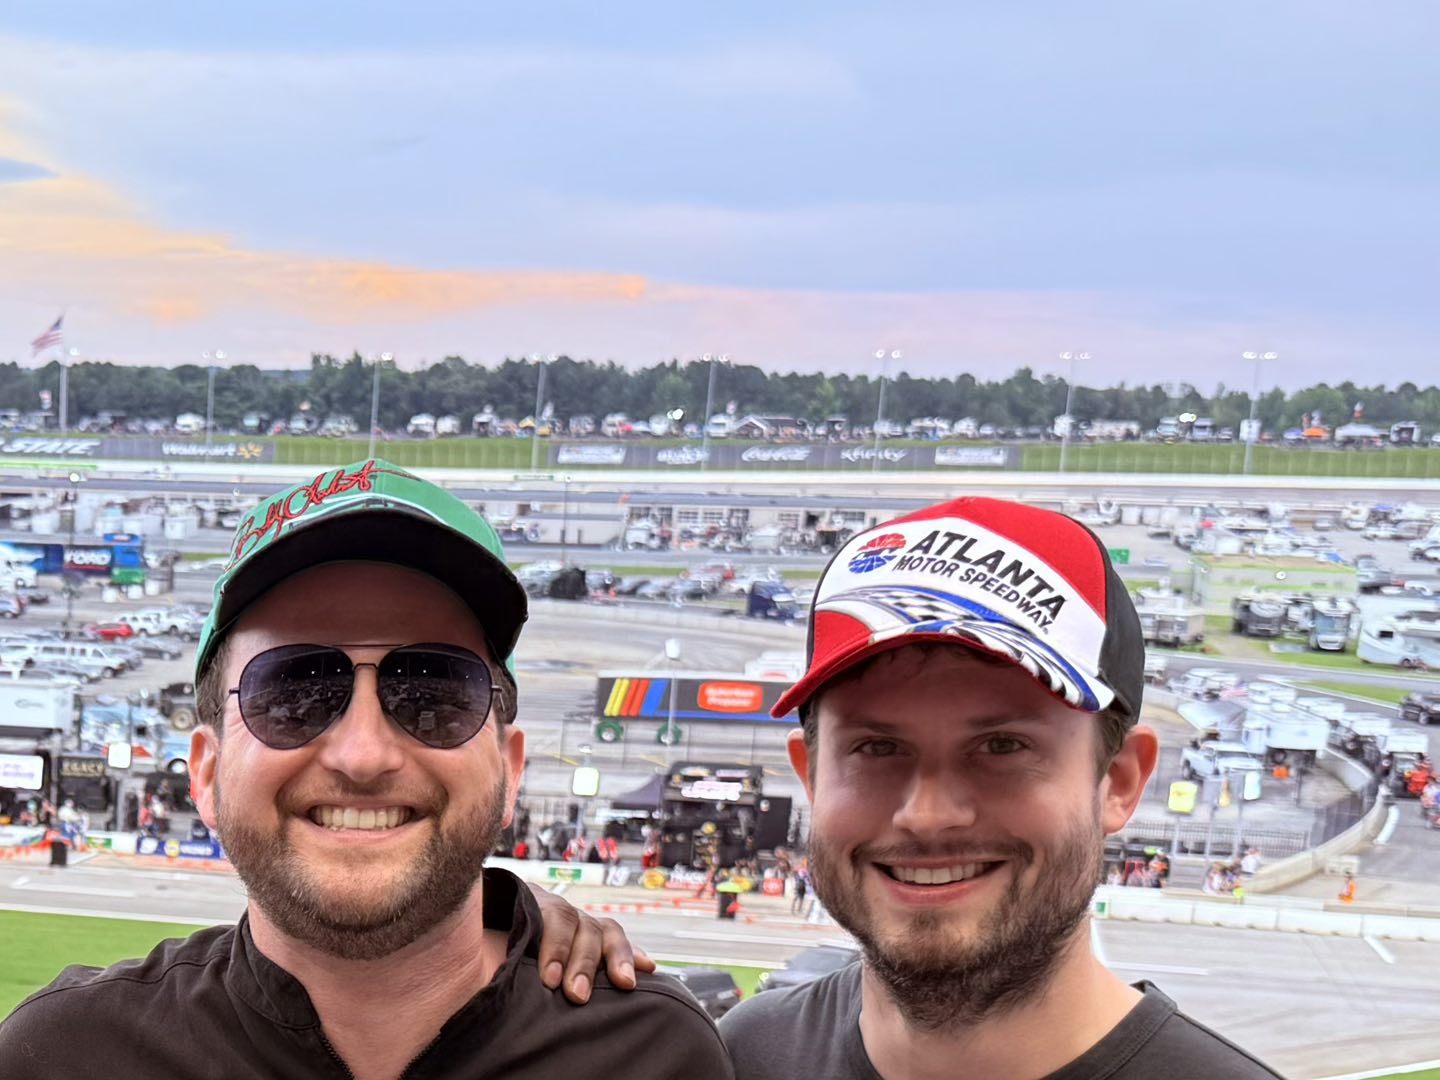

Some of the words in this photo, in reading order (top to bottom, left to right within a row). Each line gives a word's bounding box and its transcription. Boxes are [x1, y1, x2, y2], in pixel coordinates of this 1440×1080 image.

[0, 436, 101, 456] STATE
[162, 441, 237, 457] Walmart
[892, 554, 960, 578] MOTOR
[959, 567, 1053, 632] SPEEDWAY
[907, 530, 1067, 621] ATLANTA
